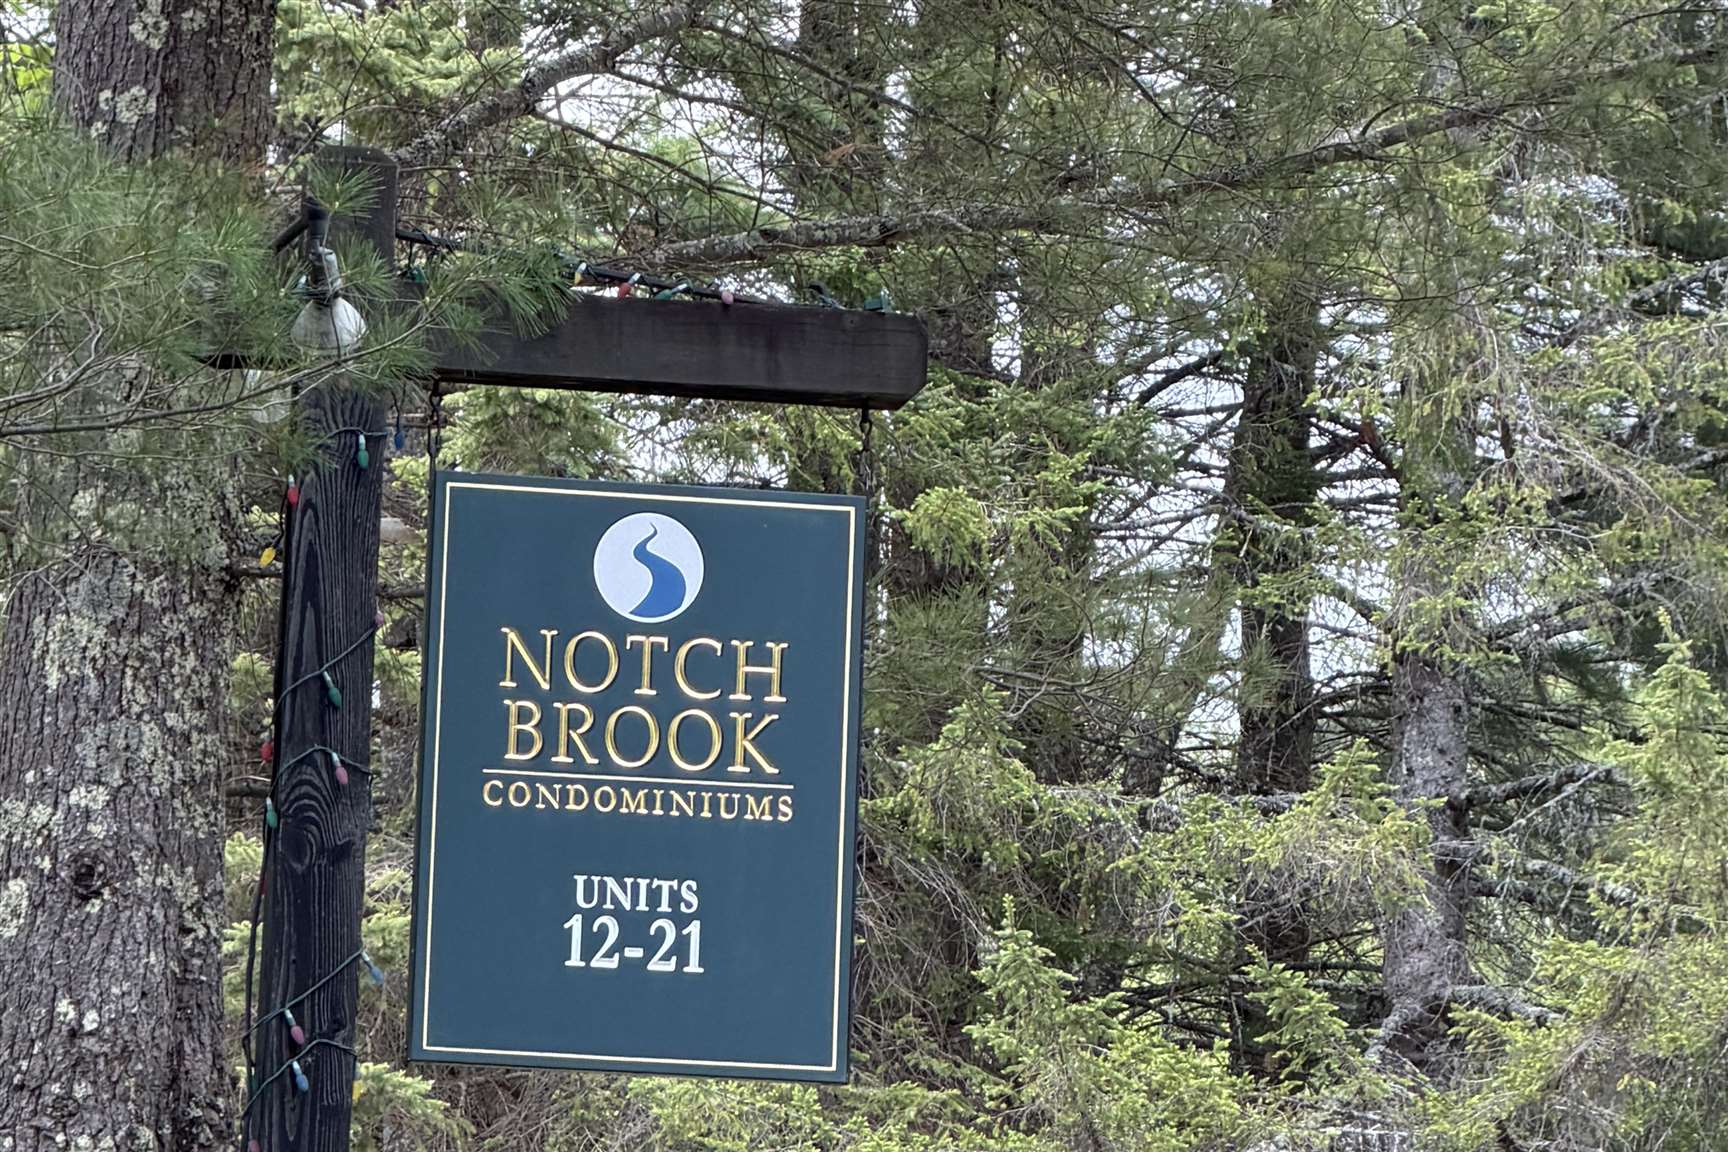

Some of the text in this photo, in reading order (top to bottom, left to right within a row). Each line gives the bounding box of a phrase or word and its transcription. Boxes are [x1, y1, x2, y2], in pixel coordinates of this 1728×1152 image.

[499, 627, 789, 703] NOTCH
[503, 698, 780, 776] BROOK
[482, 780, 794, 822] CONDOMINIUMS
[573, 874, 699, 913] UNITS
[563, 912, 705, 974] 12-21
